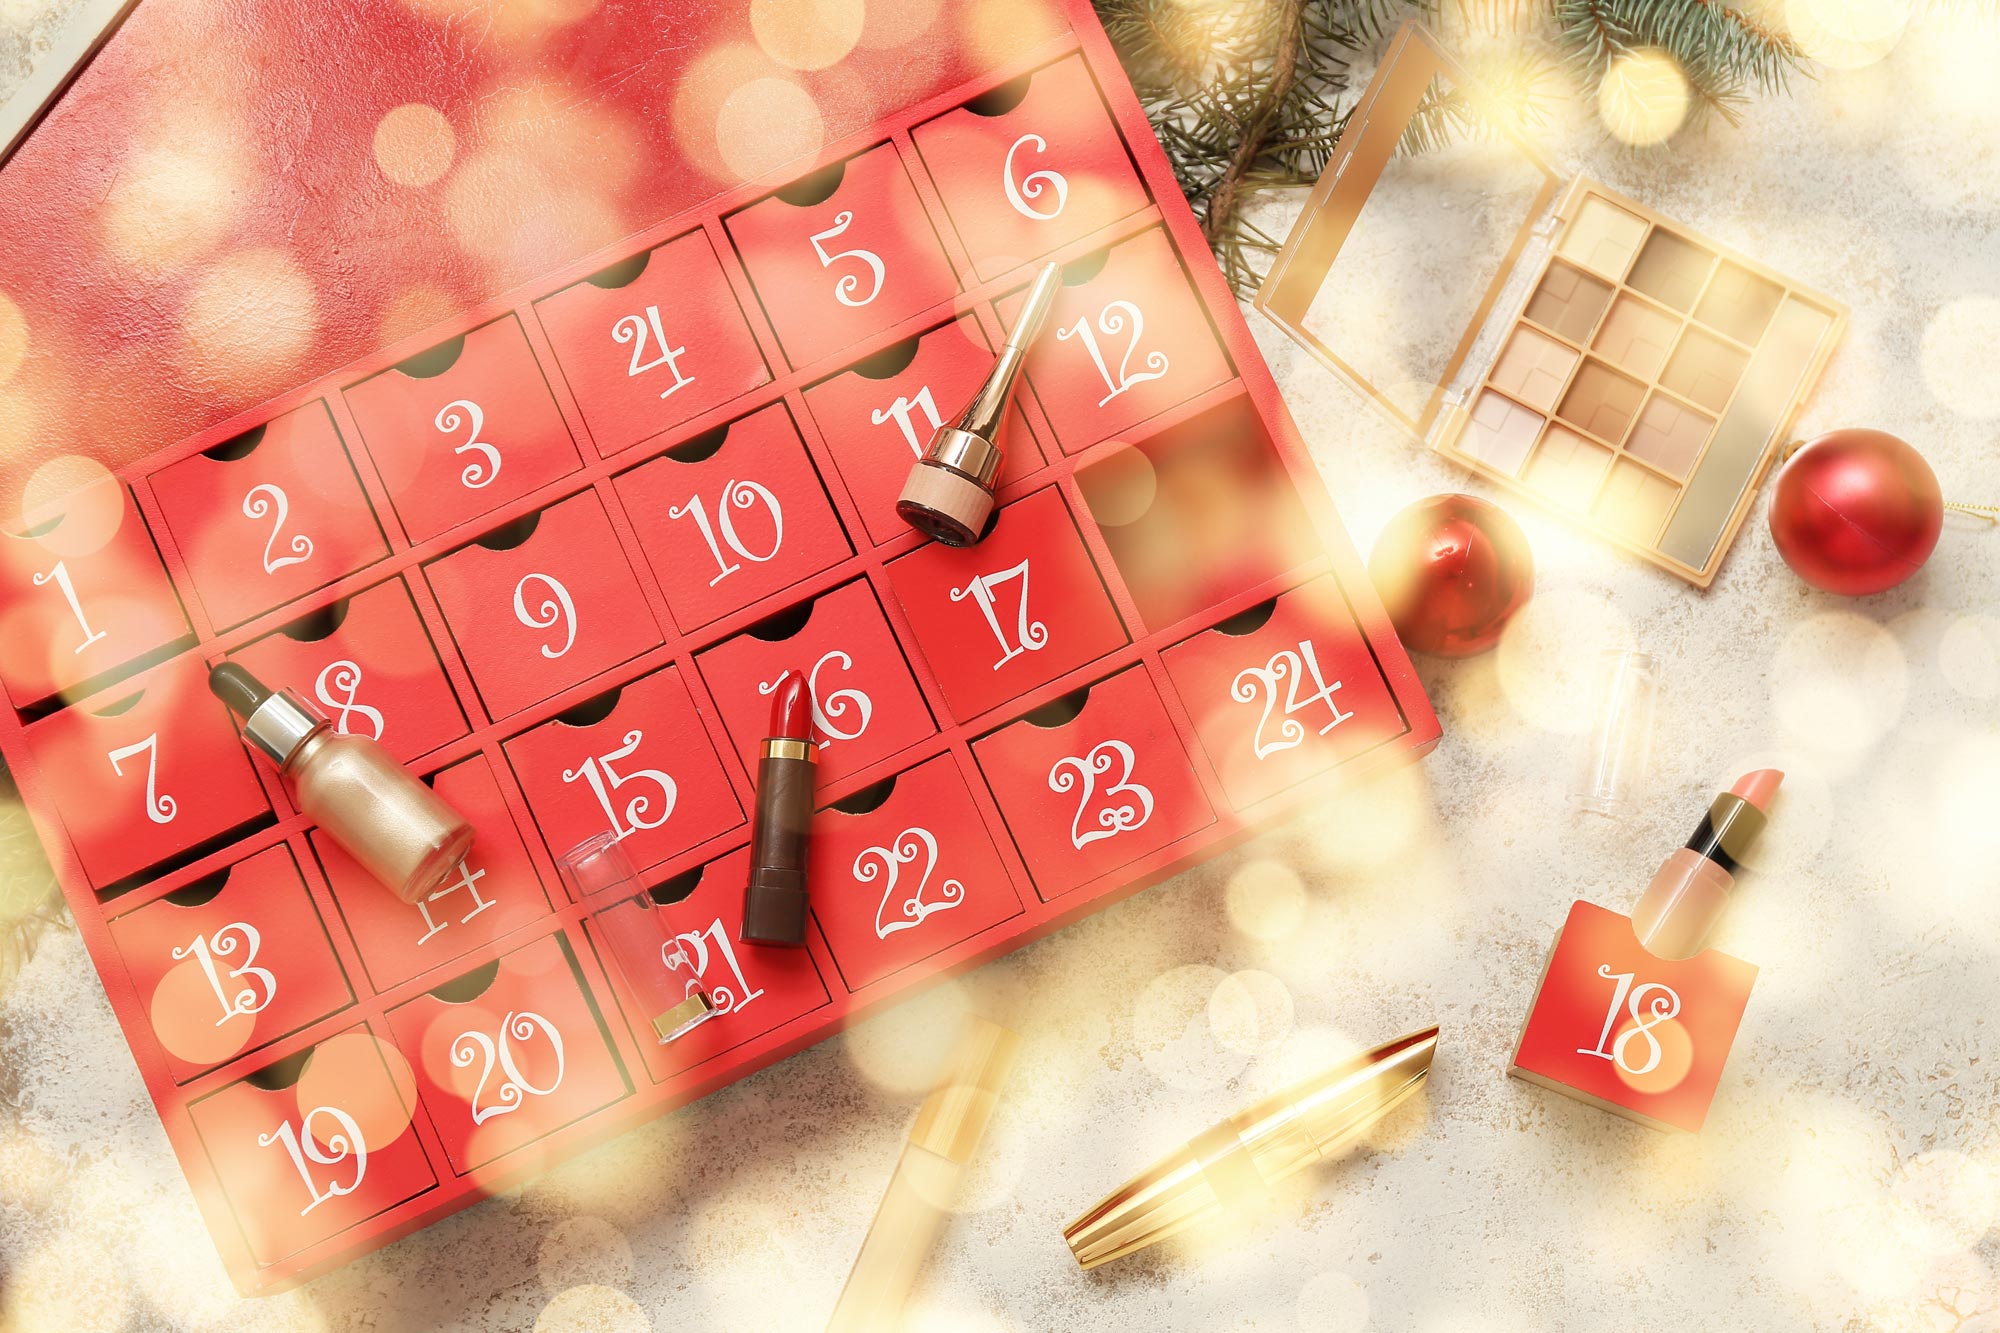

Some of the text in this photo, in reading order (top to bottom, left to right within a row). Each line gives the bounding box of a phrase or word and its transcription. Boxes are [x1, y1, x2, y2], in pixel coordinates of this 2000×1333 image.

[1003, 133, 1068, 220] 6
[810, 210, 885, 307] 5
[611, 305, 695, 399] 4
[1057, 300, 1169, 407] 12
[434, 400, 502, 489] 3
[243, 483, 314, 575] 2
[669, 479, 783, 587] 10
[33, 561, 106, 654] 1
[513, 573, 577, 659] 9
[950, 558, 1048, 671] 17
[1230, 640, 1354, 760] 24
[108, 733, 177, 823] 7
[562, 730, 678, 841] 15
[1048, 740, 1154, 850] 23
[852, 827, 965, 940] 22
[171, 922, 277, 1027] 13
[1576, 963, 1681, 1074] 18
[450, 1010, 564, 1126] 20
[258, 1106, 367, 1216] 19
